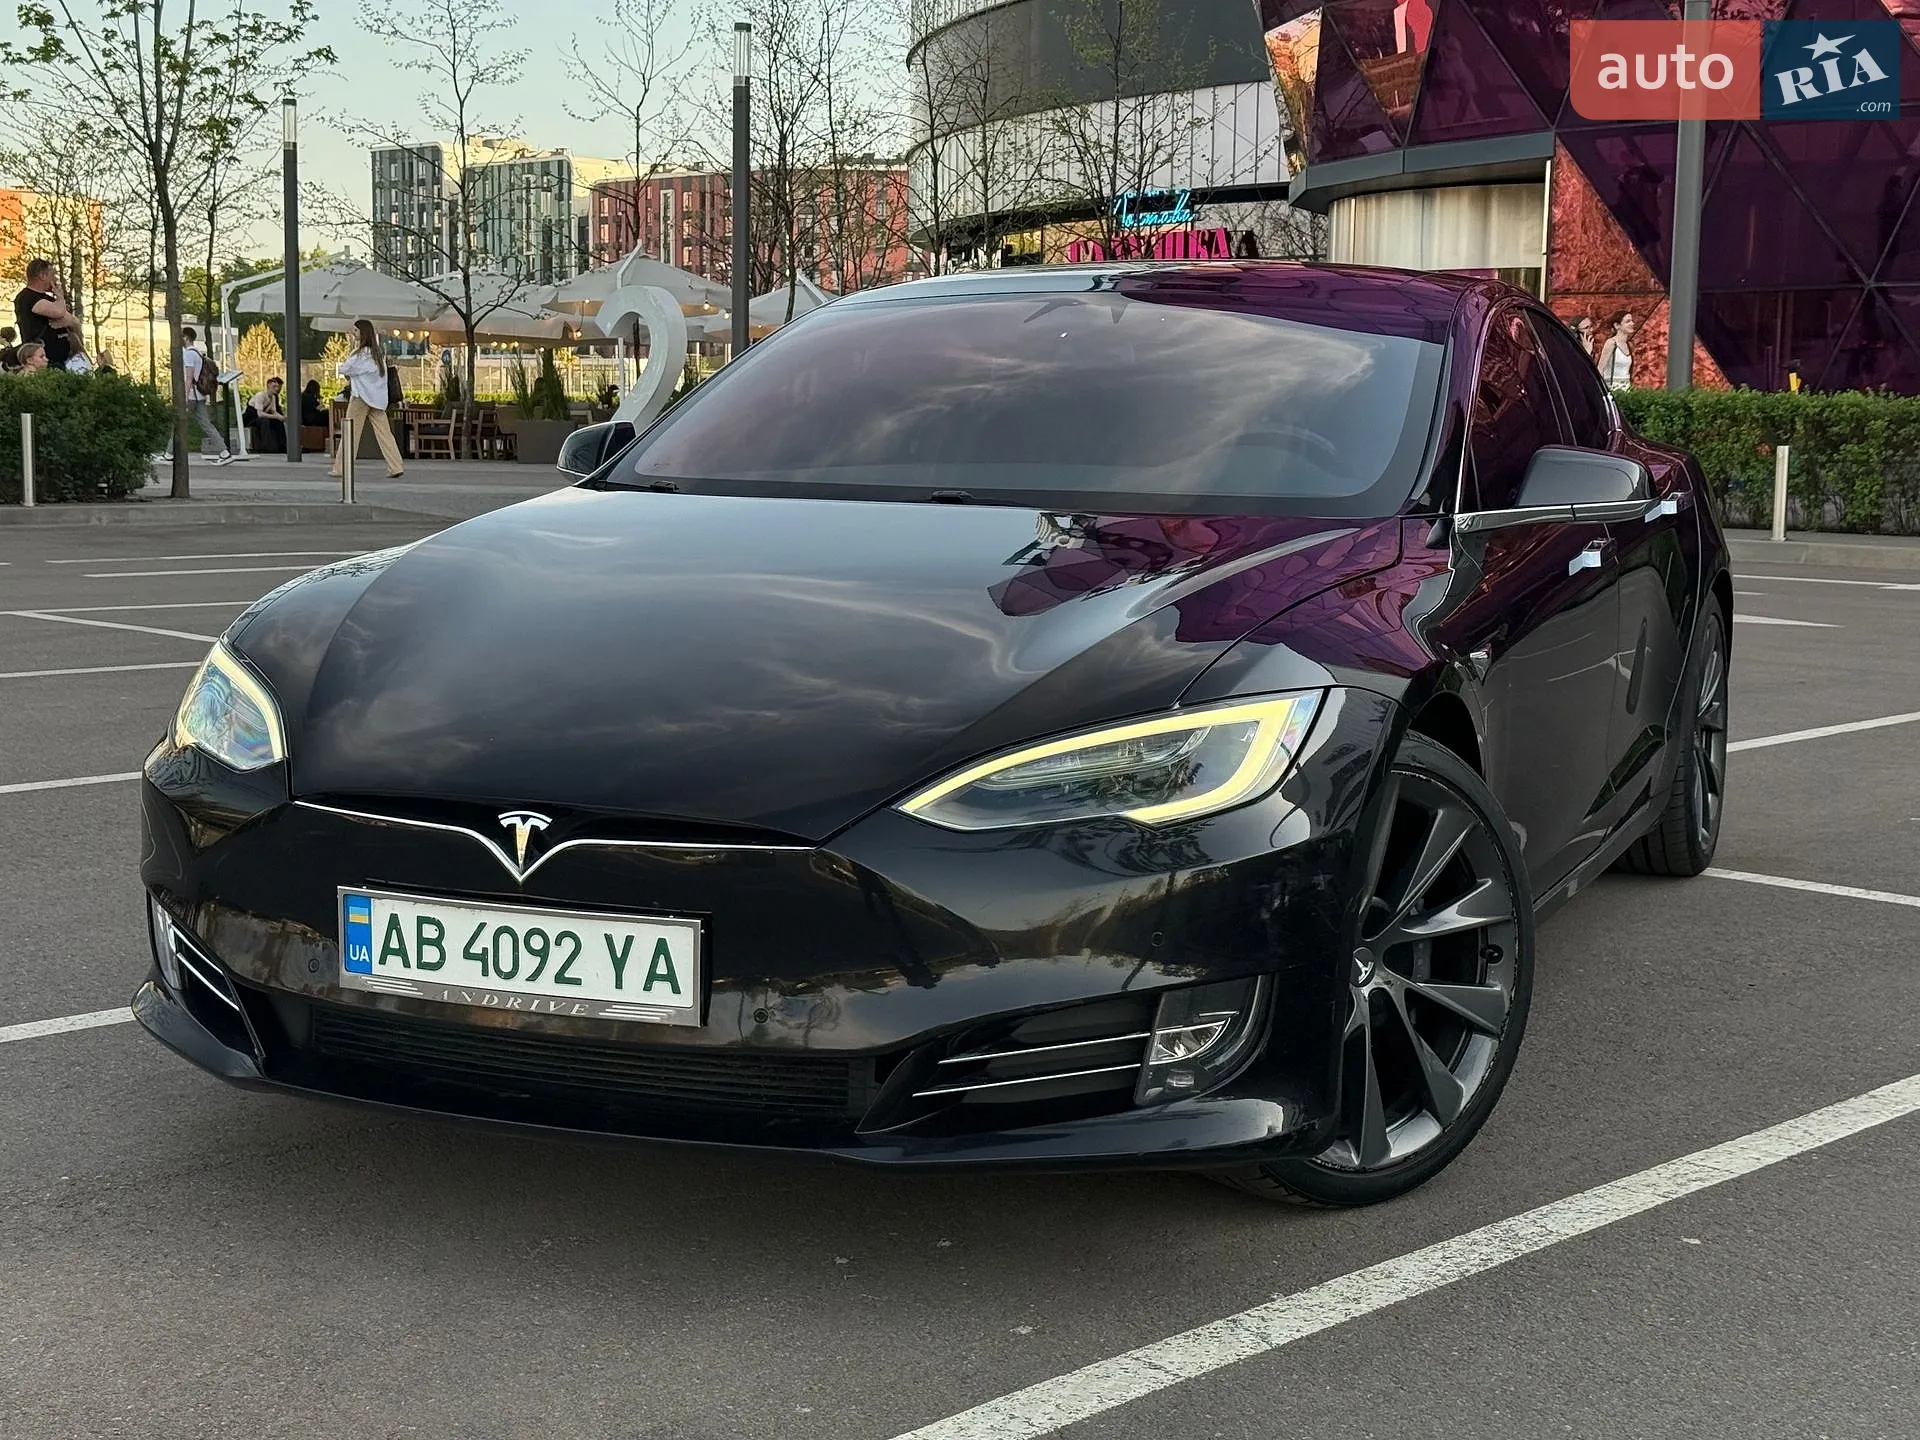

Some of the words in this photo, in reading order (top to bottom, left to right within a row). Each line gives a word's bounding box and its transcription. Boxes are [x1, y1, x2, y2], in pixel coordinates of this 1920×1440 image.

[349, 944, 370, 963] UA
[378, 912, 447, 971] AB
[462, 921, 583, 986] 4092
[604, 933, 682, 995] YA
[437, 989, 590, 1016] ANDRIVE
